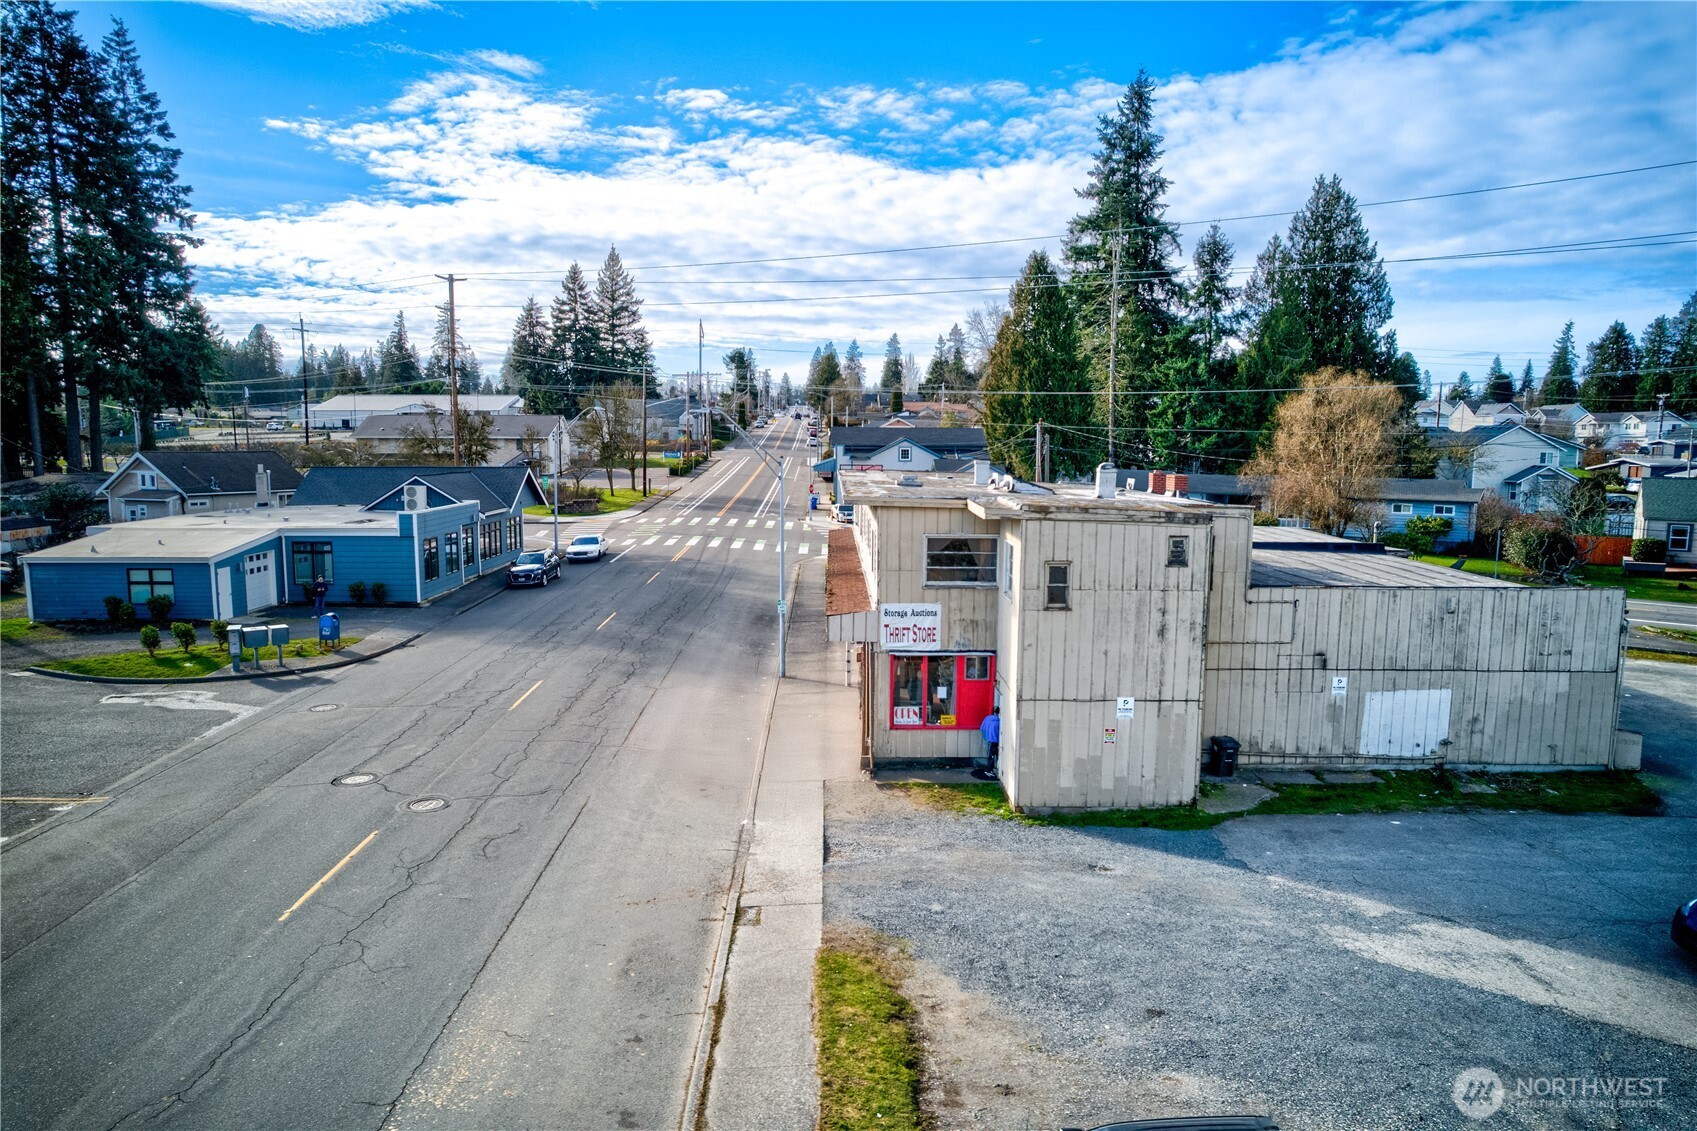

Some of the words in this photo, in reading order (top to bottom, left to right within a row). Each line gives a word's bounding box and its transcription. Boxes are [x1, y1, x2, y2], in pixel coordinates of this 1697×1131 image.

[884, 608, 908, 618] Storage
[911, 608, 937, 617] Auctions
[884, 624, 911, 643] THRIFT
[912, 624, 937, 643] STORE
[895, 707, 919, 719] OPEN
